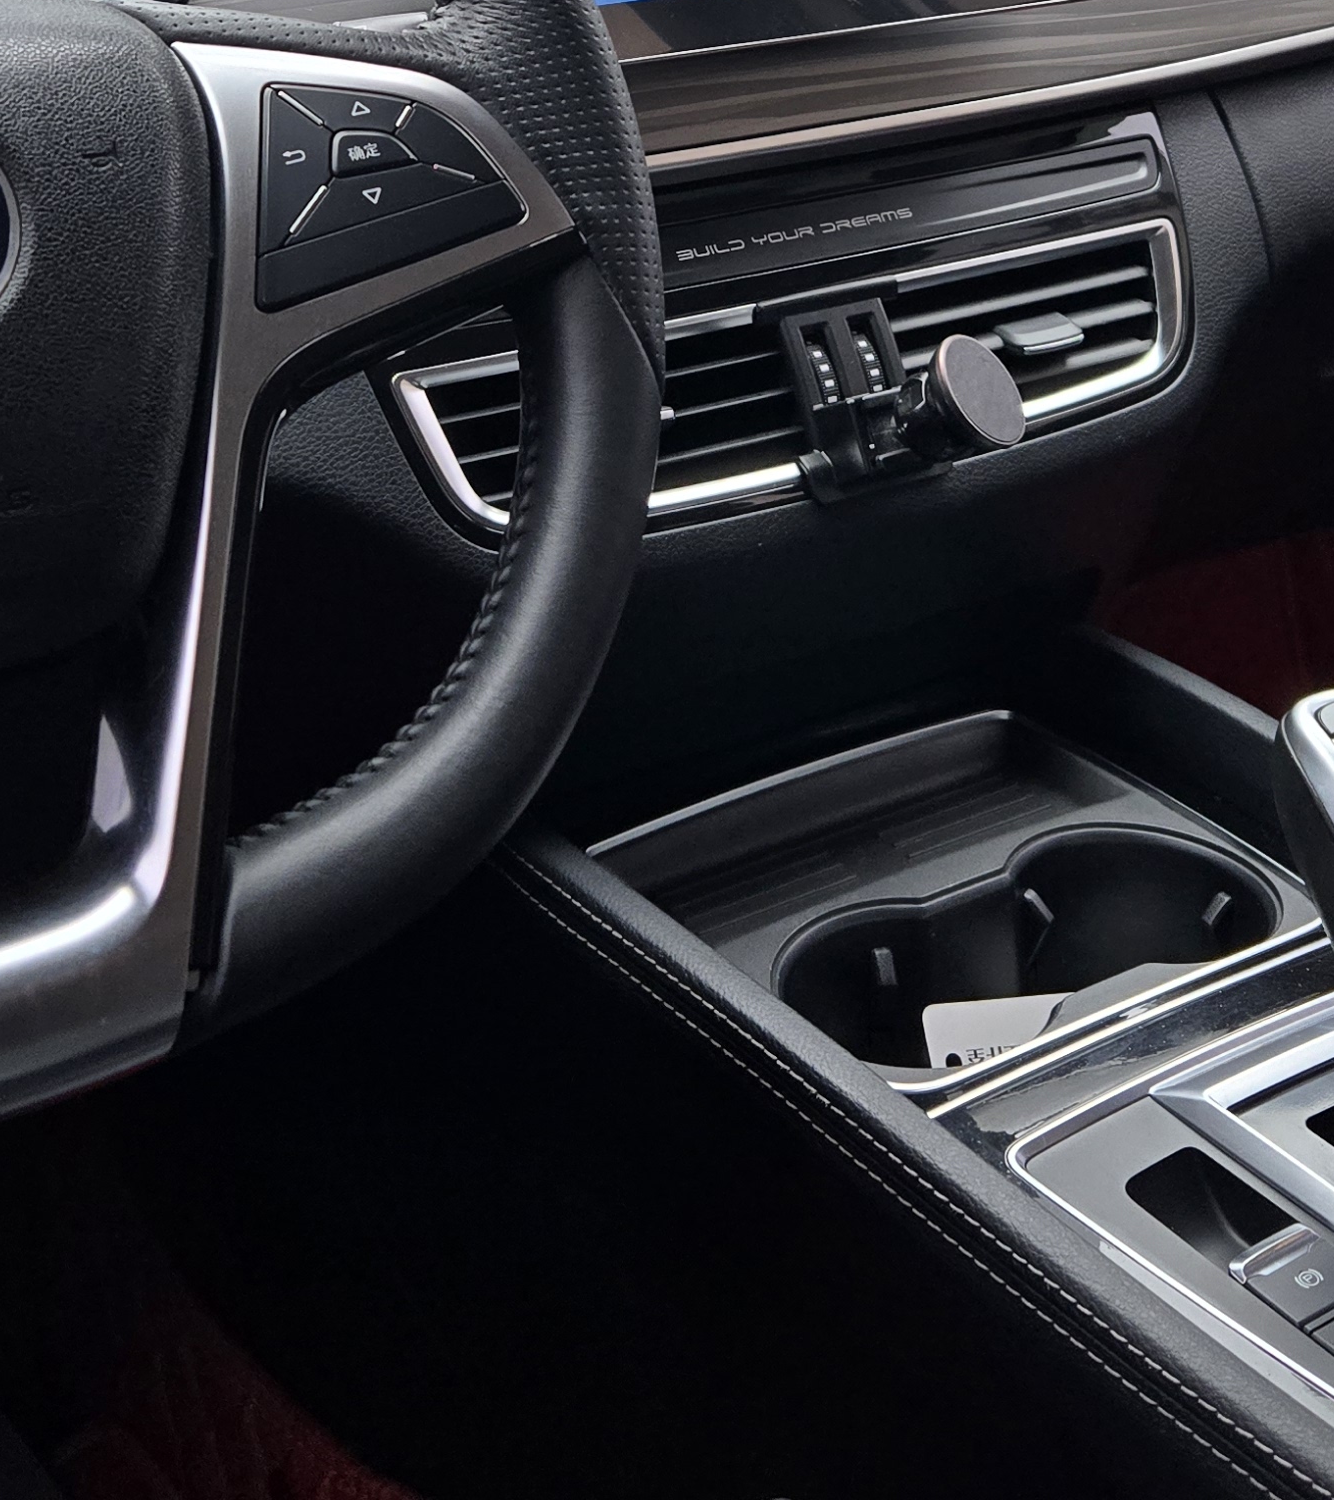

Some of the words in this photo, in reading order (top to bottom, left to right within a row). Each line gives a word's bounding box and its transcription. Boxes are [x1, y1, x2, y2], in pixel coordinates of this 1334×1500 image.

[347, 142, 381, 161] 确定
[675, 239, 745, 262] BUILD
[751, 225, 815, 246] YOUR
[819, 207, 913, 234] DREAMS
